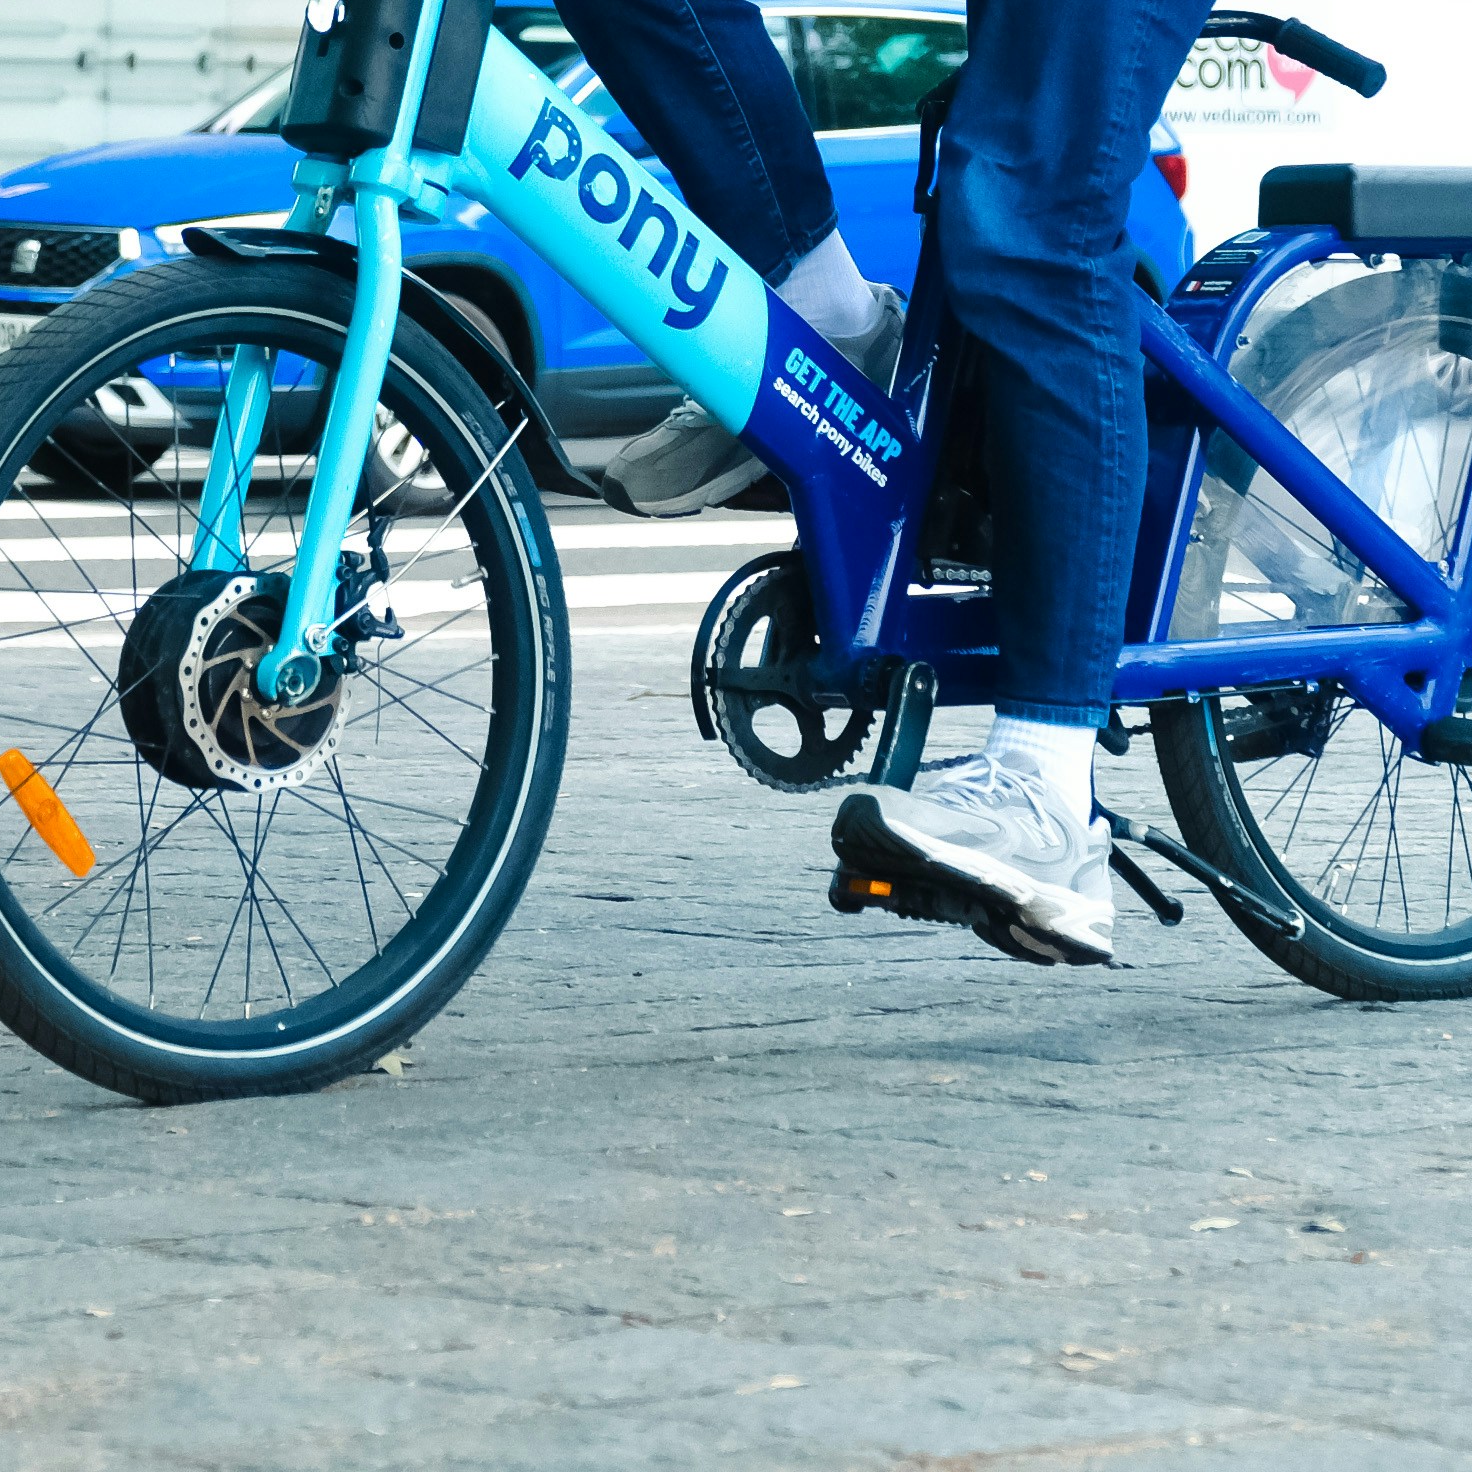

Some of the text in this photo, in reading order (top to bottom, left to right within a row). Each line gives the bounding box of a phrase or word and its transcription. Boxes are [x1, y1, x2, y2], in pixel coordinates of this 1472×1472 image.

[507, 97, 730, 330] pony
[773, 376, 888, 488] search pony bikes
[784, 347, 903, 462] GET THE APP
